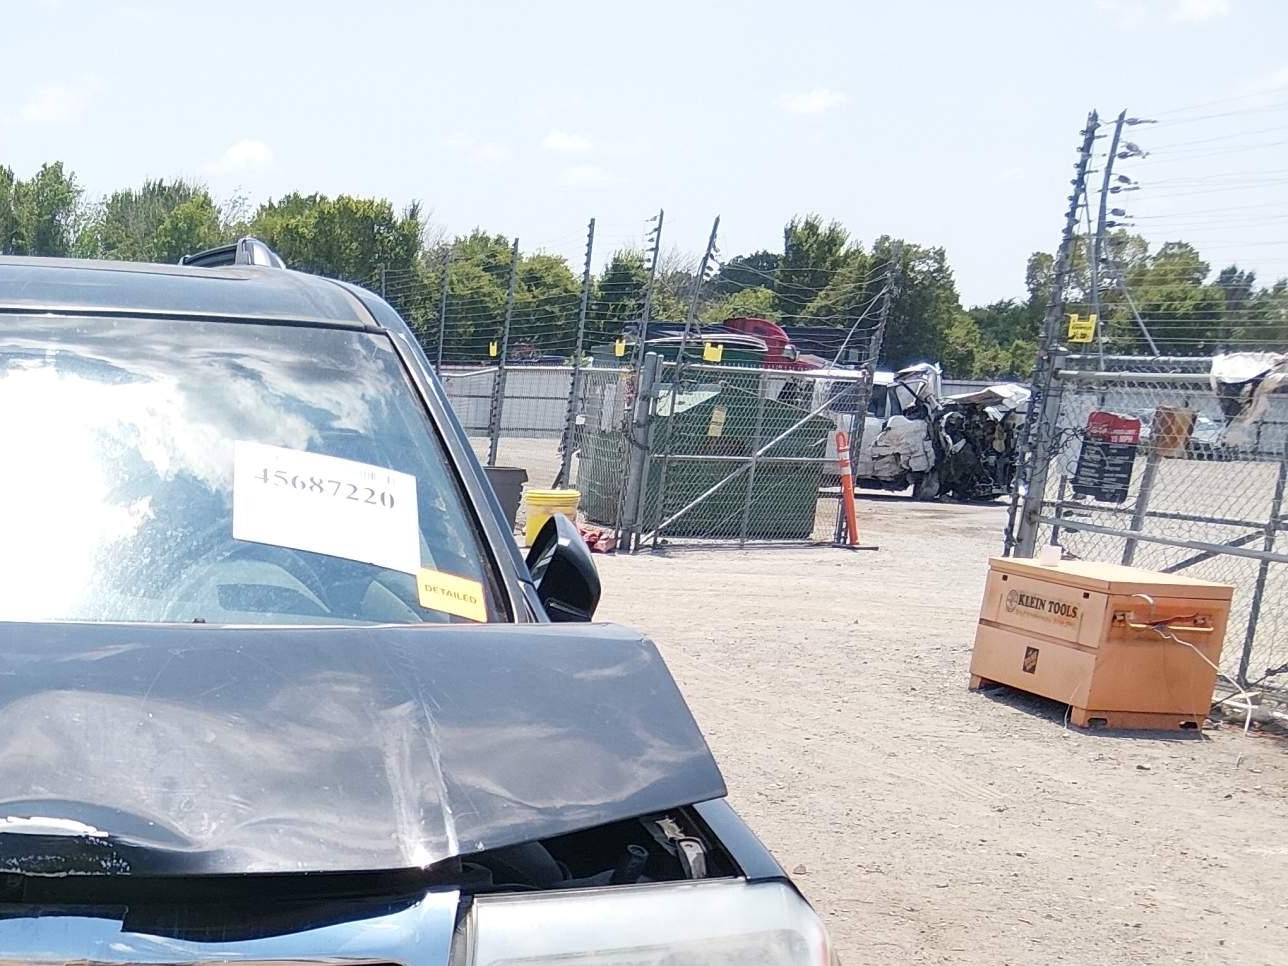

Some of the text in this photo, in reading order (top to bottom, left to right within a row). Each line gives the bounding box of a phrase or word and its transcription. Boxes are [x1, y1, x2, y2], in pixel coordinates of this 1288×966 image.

[254, 468, 396, 508] 45687220
[424, 584, 478, 604] DETAILED
[1018, 593, 1047, 610] KLEIN
[1048, 600, 1079, 618] TOOLS
